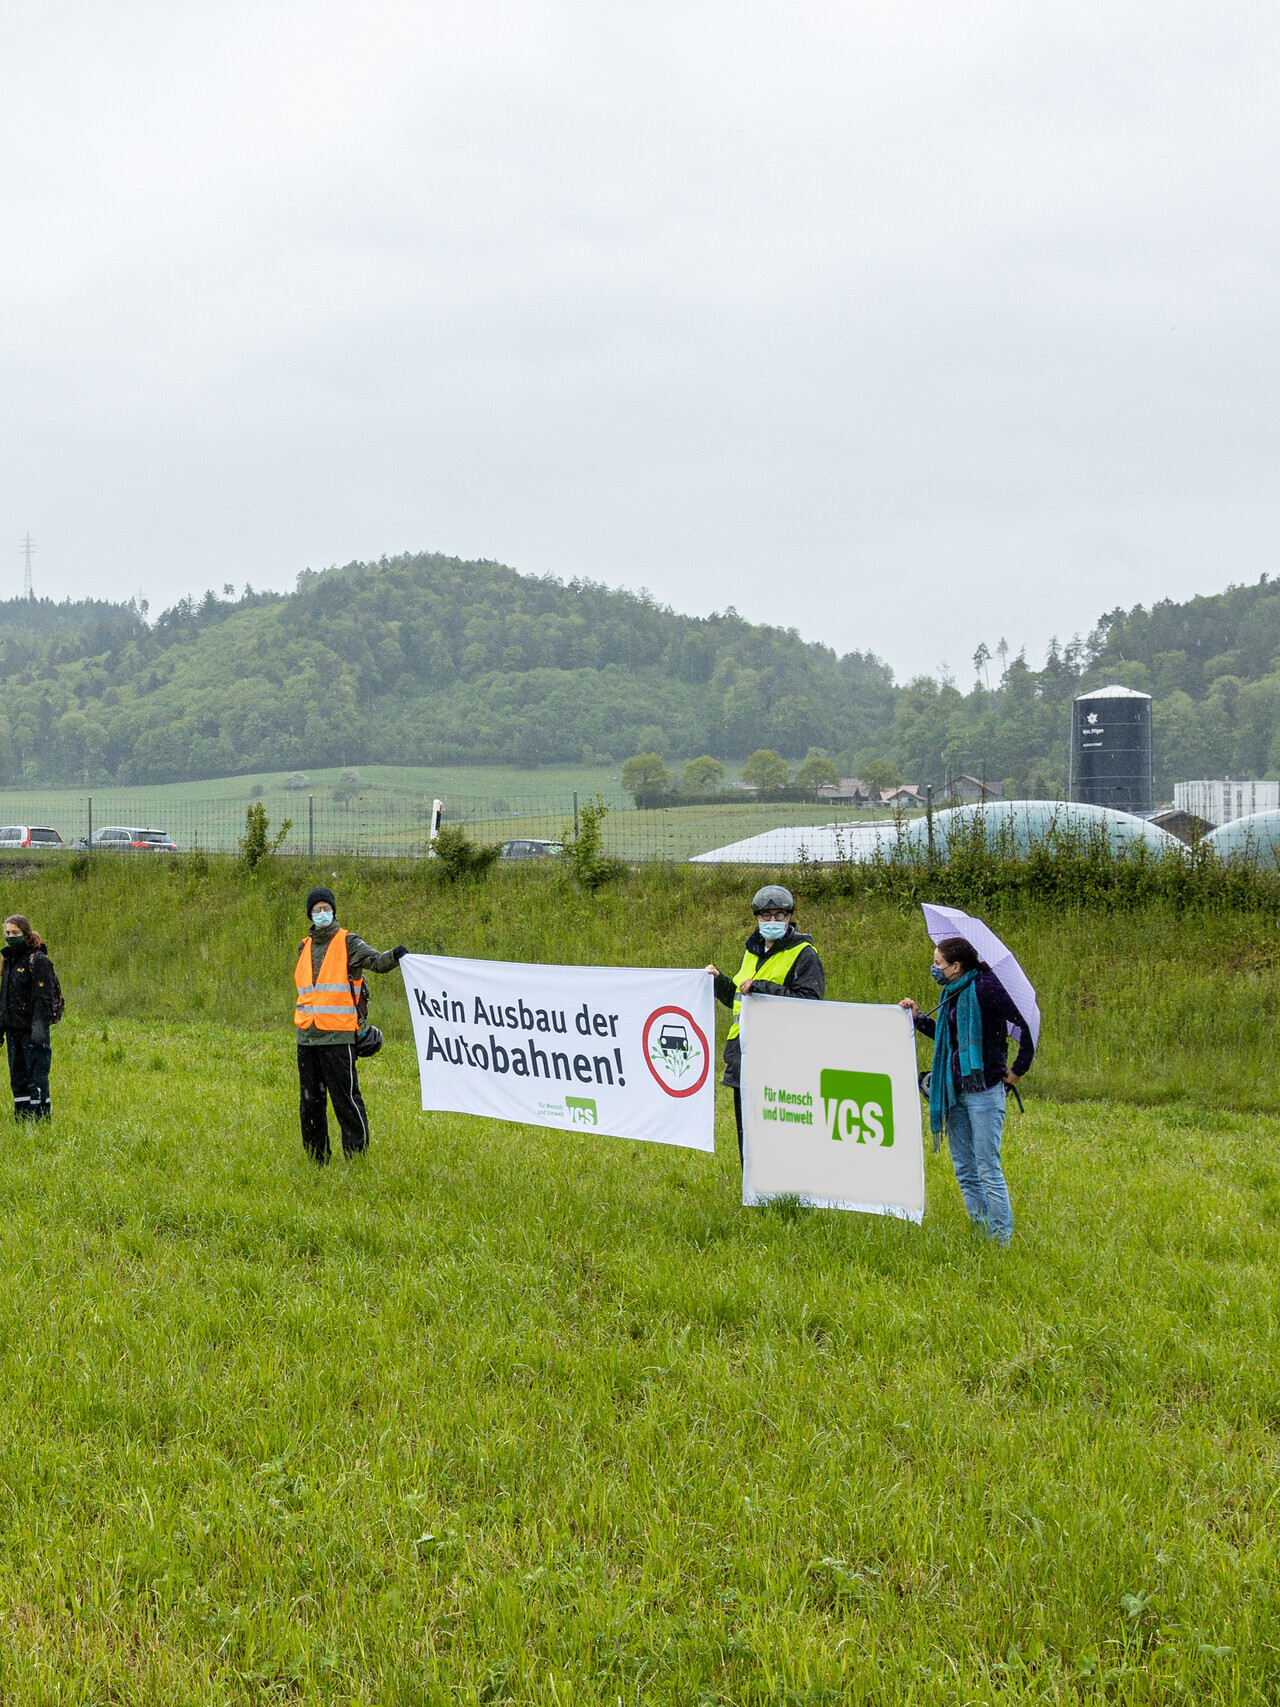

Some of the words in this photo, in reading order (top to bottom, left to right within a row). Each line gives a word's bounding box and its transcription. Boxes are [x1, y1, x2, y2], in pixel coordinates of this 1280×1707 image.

[413, 987, 466, 1023] Kein
[473, 996, 568, 1034] Ausbau
[574, 1003, 619, 1038] der
[425, 1026, 626, 1087] Autobahnen!
[538, 1101, 546, 1109] Für
[546, 1103, 564, 1111] Mensch
[764, 1084, 777, 1103] Für
[778, 1089, 813, 1107] Mensch
[566, 1105, 596, 1126] VCS
[763, 1106, 778, 1122] und
[779, 1108, 814, 1126] Umwelt
[818, 1096, 886, 1147] VCS
